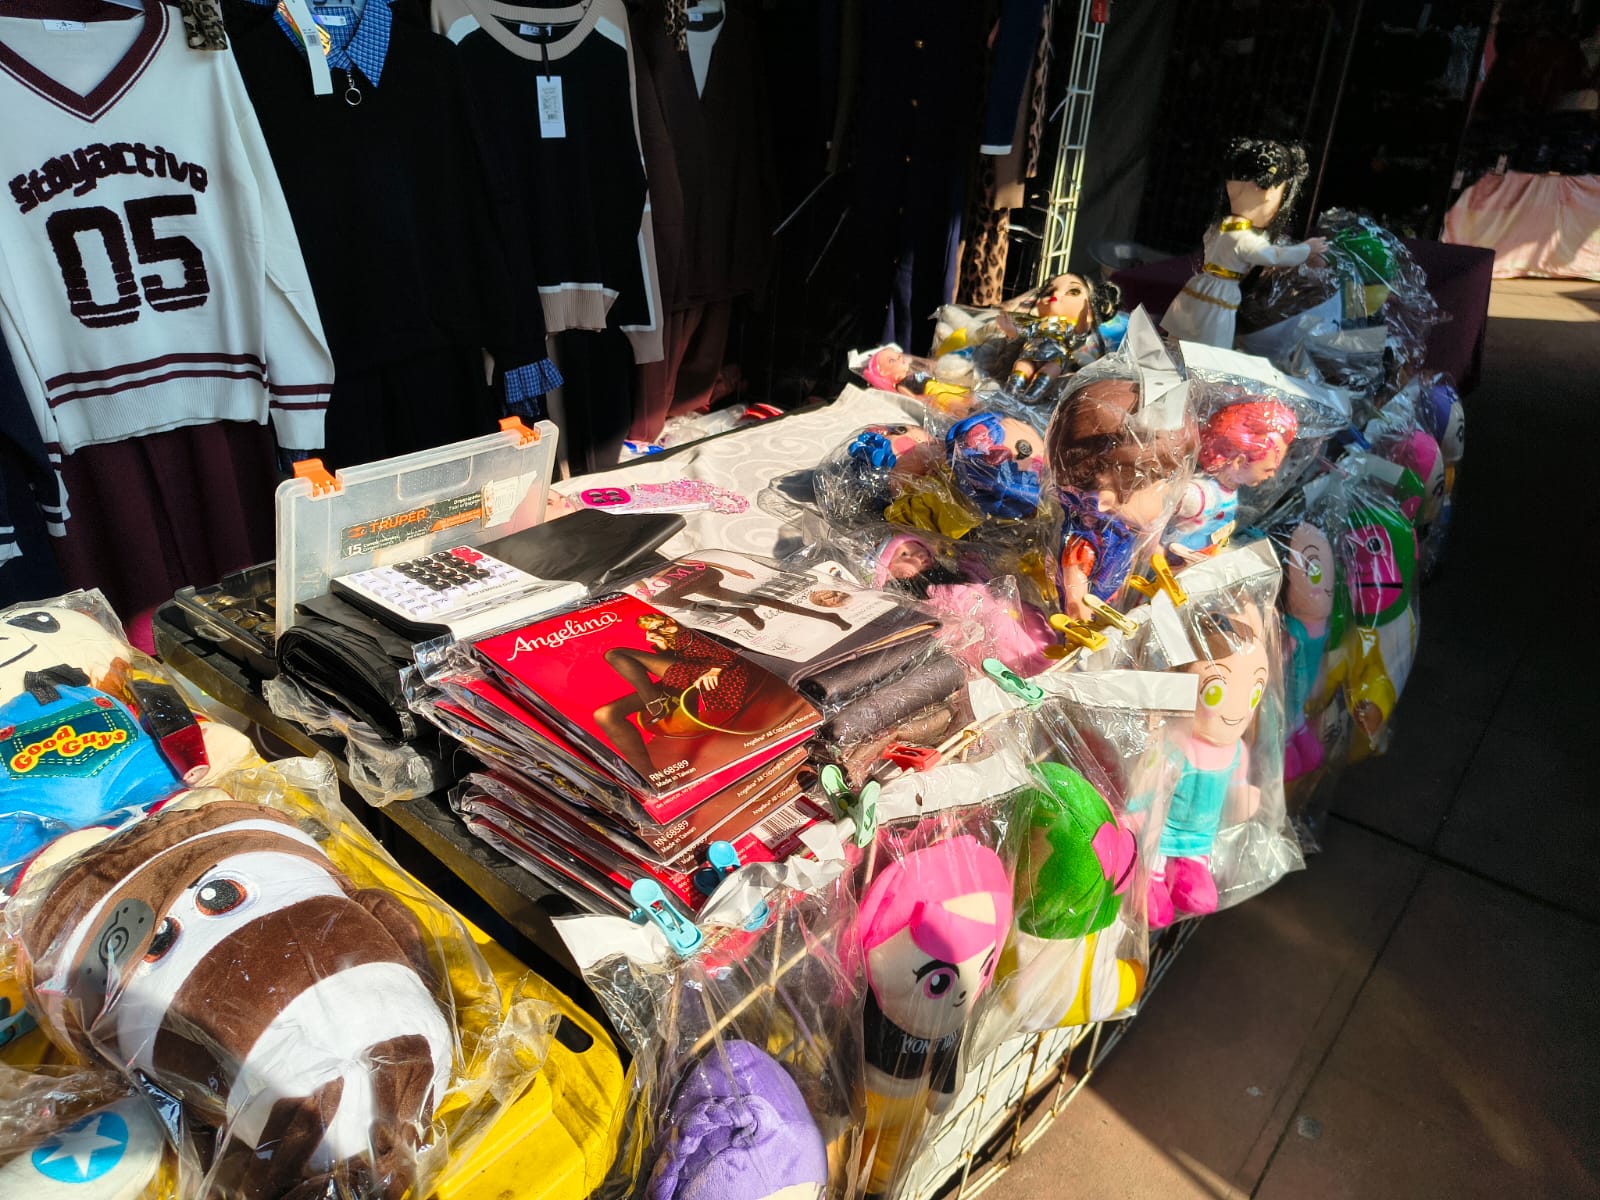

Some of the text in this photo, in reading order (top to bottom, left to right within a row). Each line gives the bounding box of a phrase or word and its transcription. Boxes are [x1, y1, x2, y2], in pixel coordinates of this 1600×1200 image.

[9, 142, 208, 214] Stayactive
[46, 194, 210, 329] 05
[369, 507, 429, 534] TRUPER
[347, 544, 362, 556] 15
[506, 611, 618, 661] Angelina
[12, 726, 126, 771] Good Guys
[649, 759, 689, 782] RN 68589
[656, 776, 673, 788] Made
[677, 767, 697, 778] Taiwan
[653, 834, 668, 848] RN
[665, 820, 689, 838] 68589
[660, 840, 676, 853] Made
[679, 826, 697, 841] Taiwan
